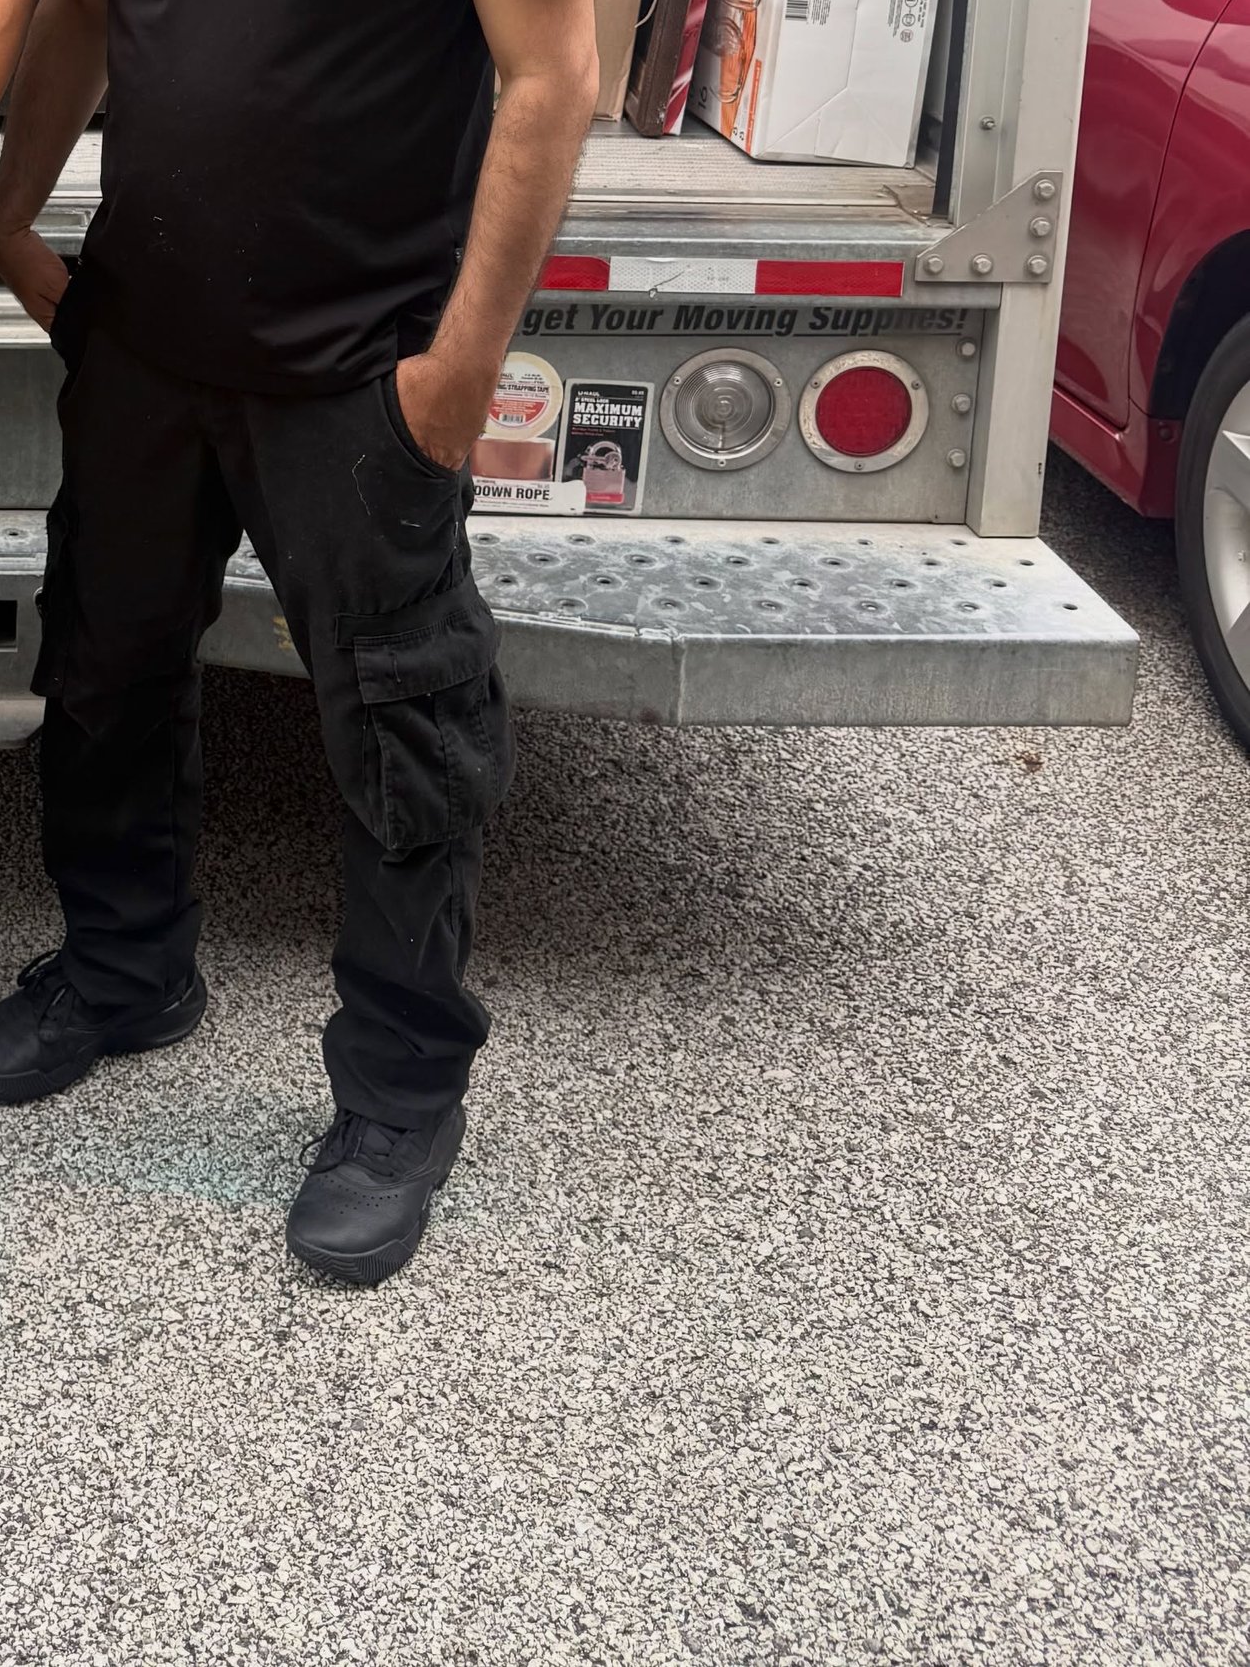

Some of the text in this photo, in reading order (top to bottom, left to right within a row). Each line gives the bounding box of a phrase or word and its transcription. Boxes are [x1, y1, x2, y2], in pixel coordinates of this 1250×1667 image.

[522, 304, 969, 337] get Your Moving Supplies!
[574, 402, 643, 416] MAXIMUM
[572, 414, 643, 428] SECURITY
[474, 486, 550, 500] DOWN ROPE
